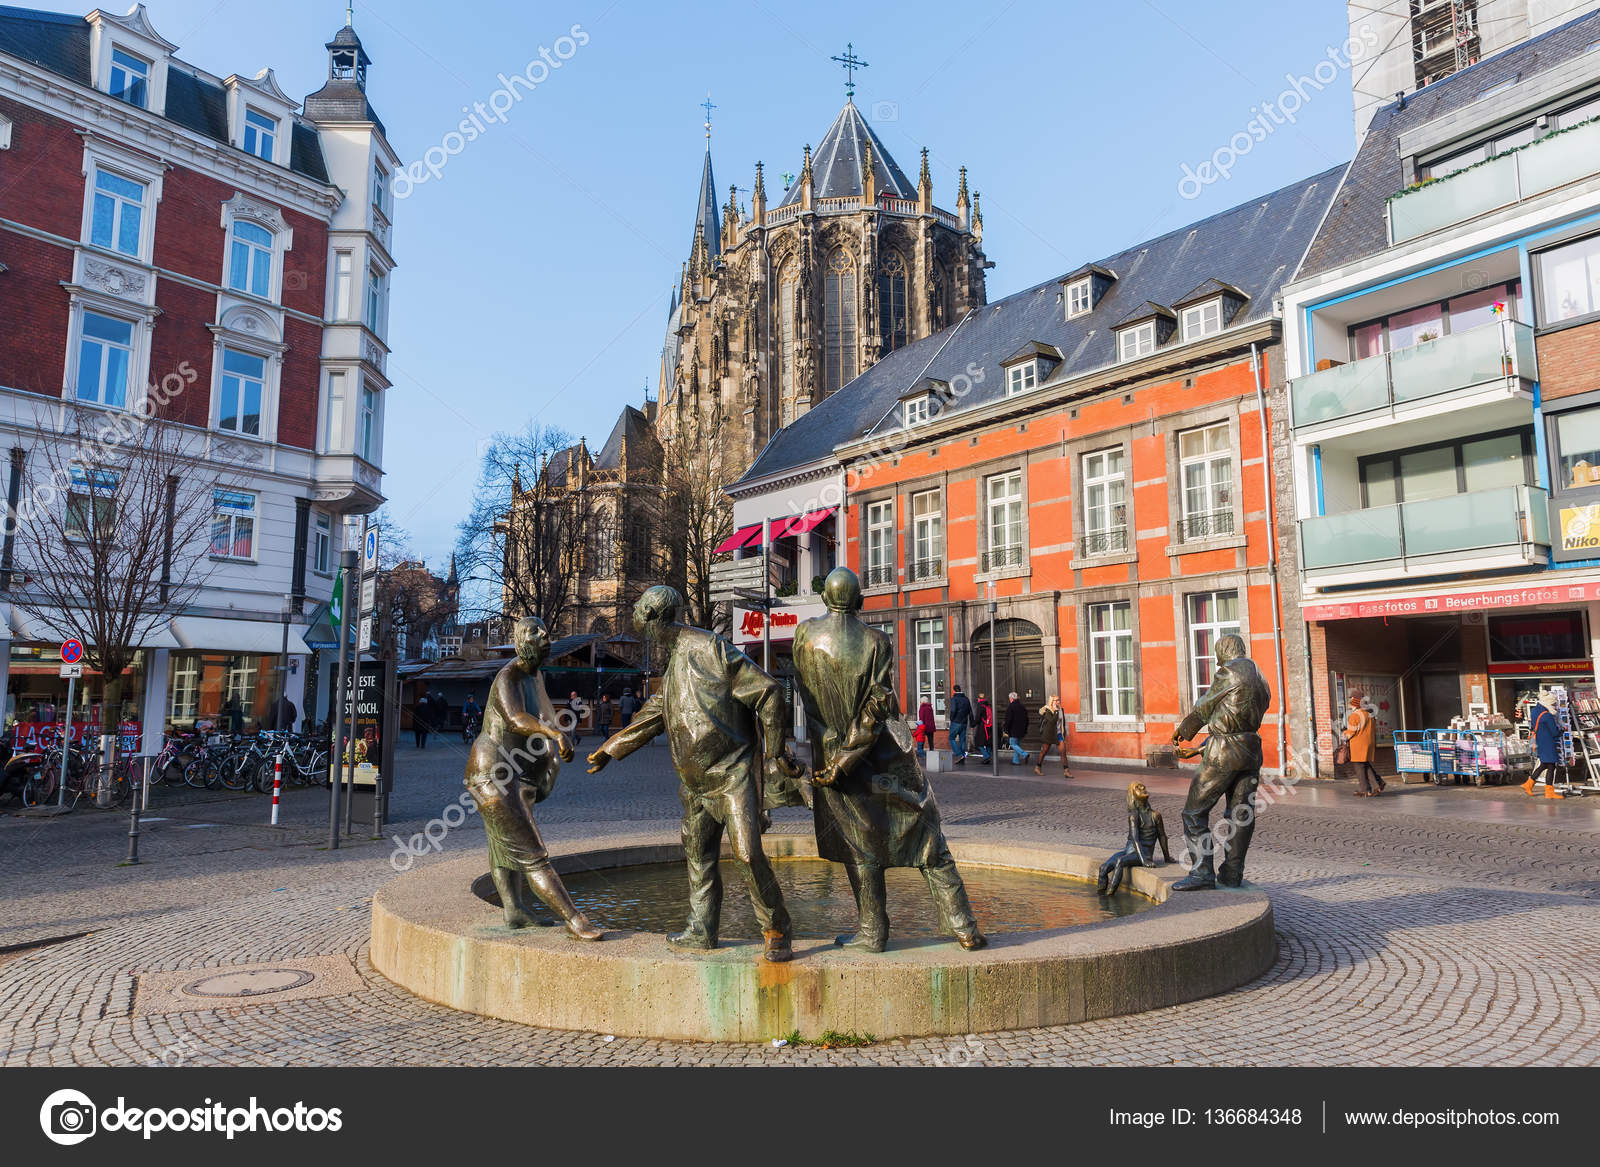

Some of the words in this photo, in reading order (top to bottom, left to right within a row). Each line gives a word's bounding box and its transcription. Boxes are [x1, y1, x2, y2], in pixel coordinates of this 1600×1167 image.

[1565, 536, 1600, 549] Niko
[1359, 600, 1417, 614] Passfotos
[1446, 590, 1559, 608] Bewerbungsfotos
[359, 676, 376, 687] ESTE
